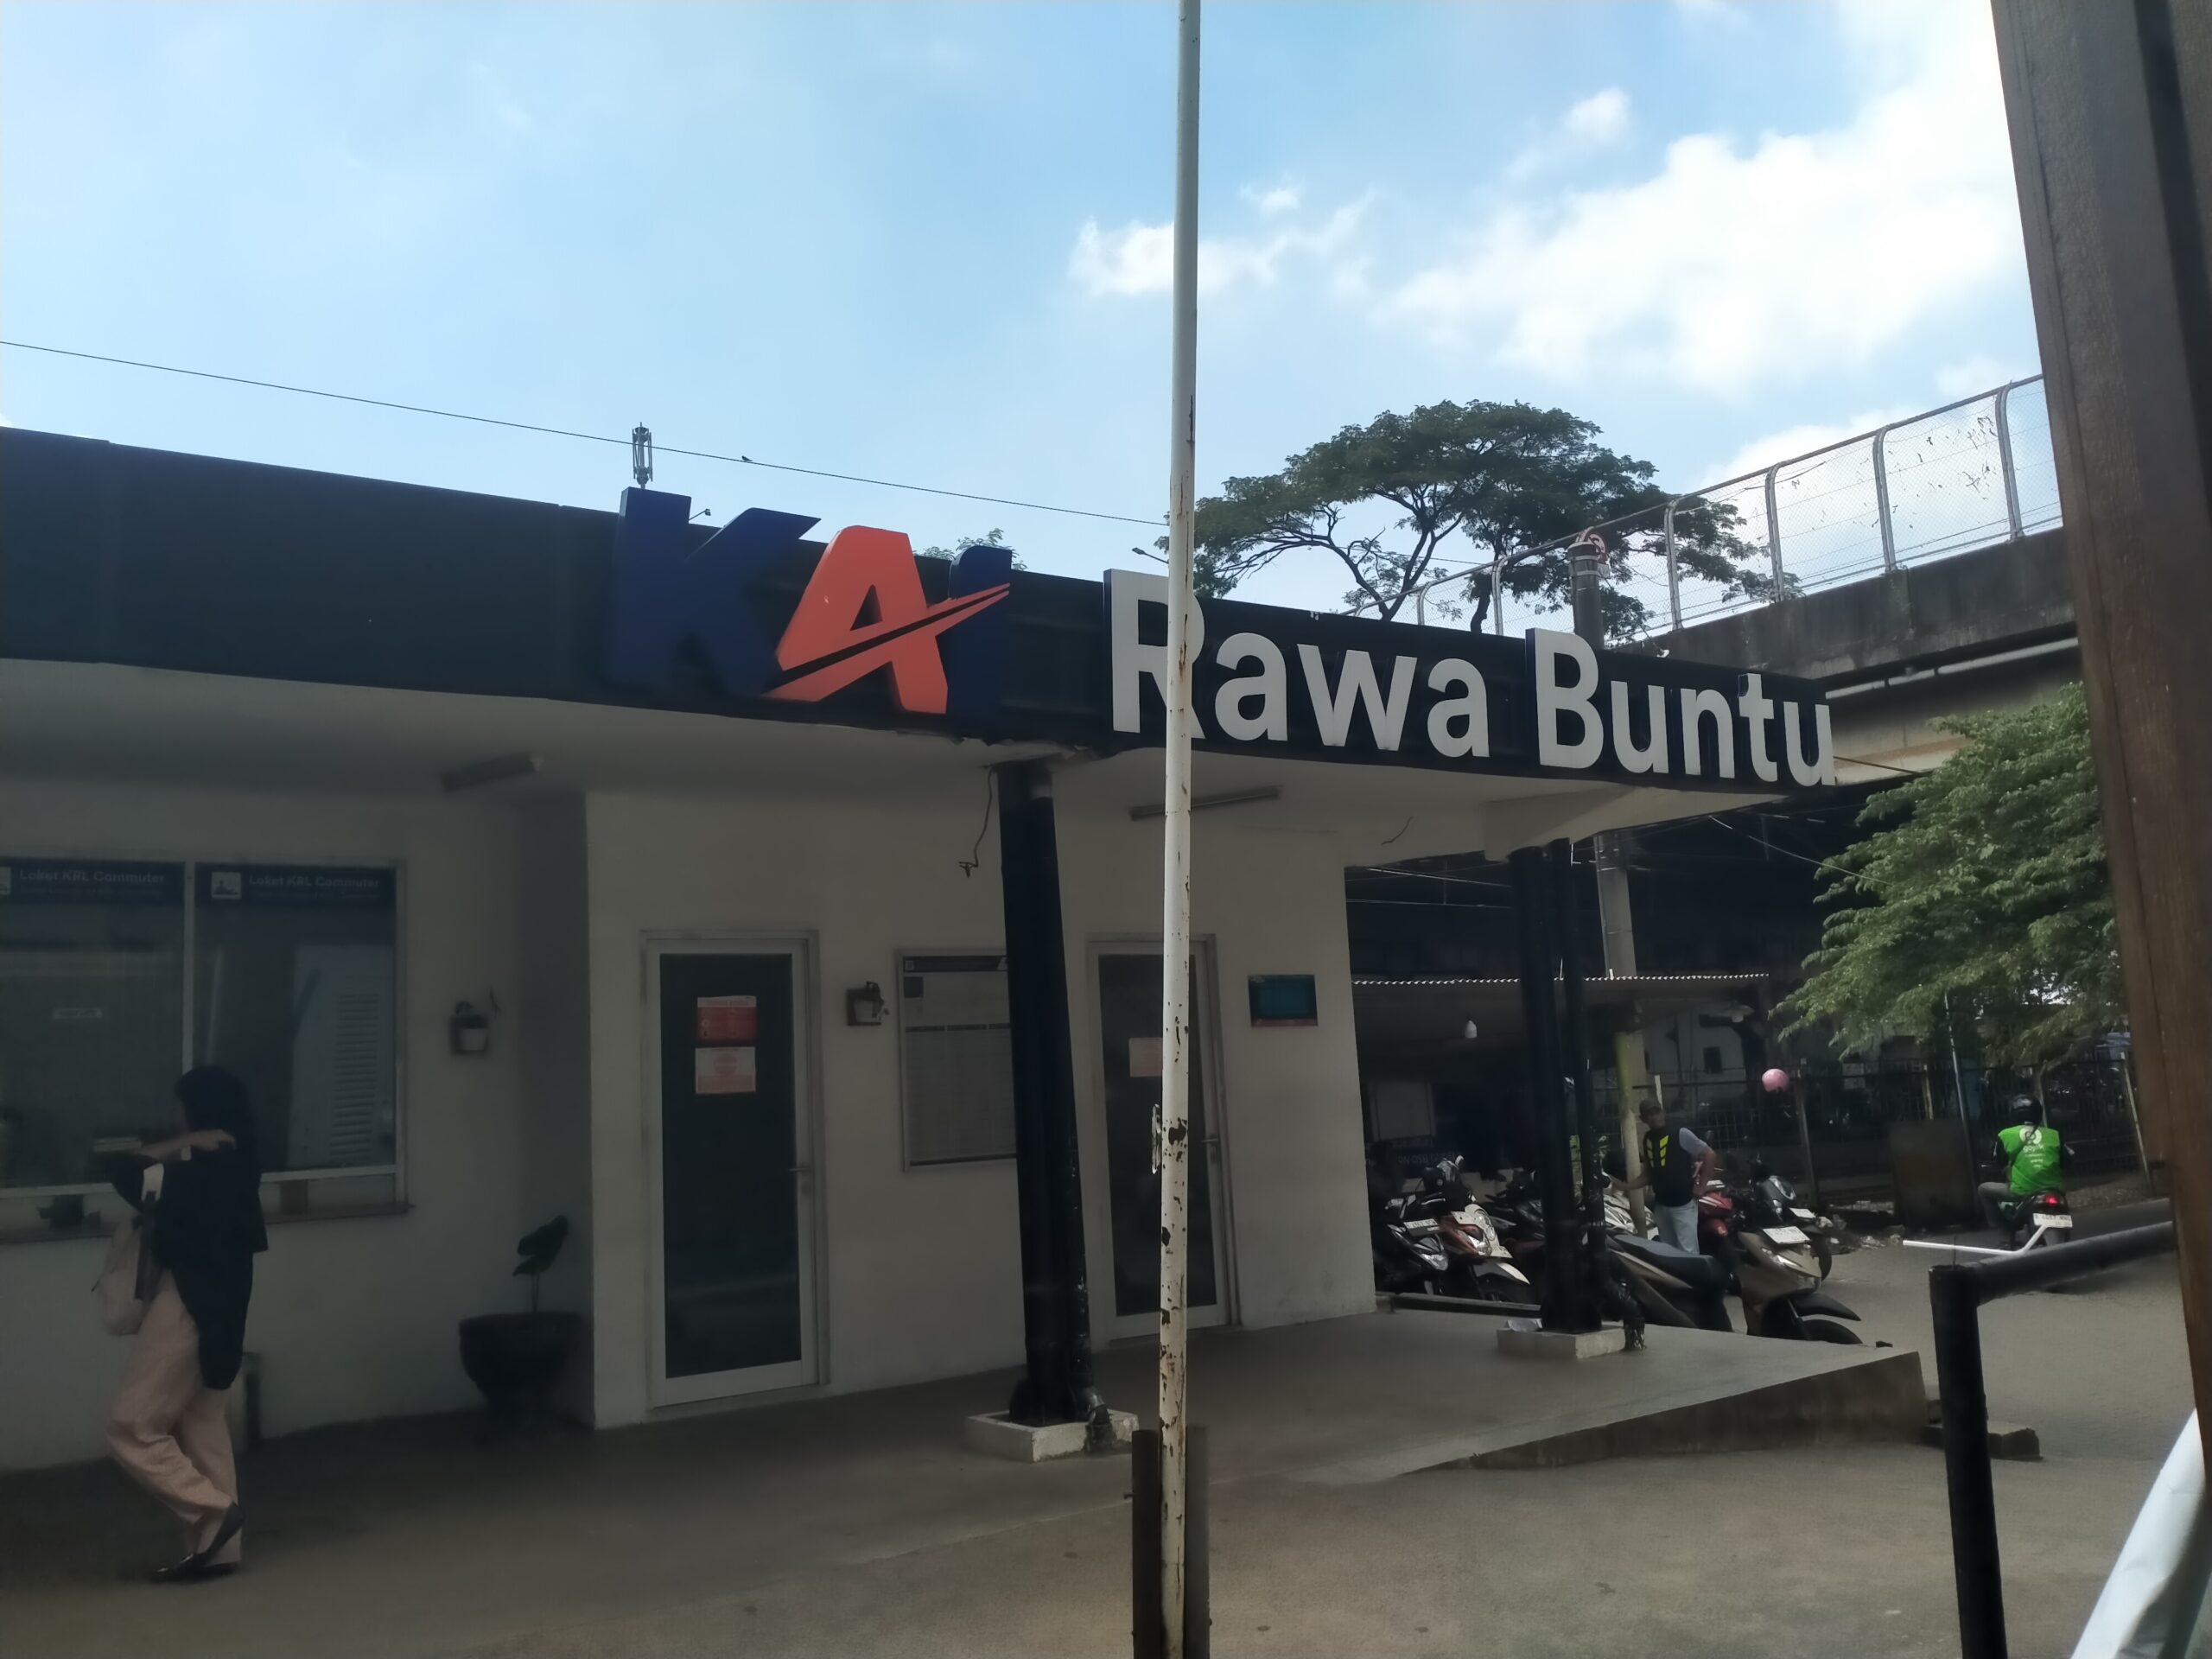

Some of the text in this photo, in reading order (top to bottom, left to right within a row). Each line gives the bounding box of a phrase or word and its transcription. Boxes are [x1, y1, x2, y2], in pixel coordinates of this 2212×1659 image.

[607, 486, 1836, 787] KAI Rawa Buntu
[20, 868, 165, 884] Loket KRL Commuter
[249, 874, 379, 889] Loket KRL Commuter
